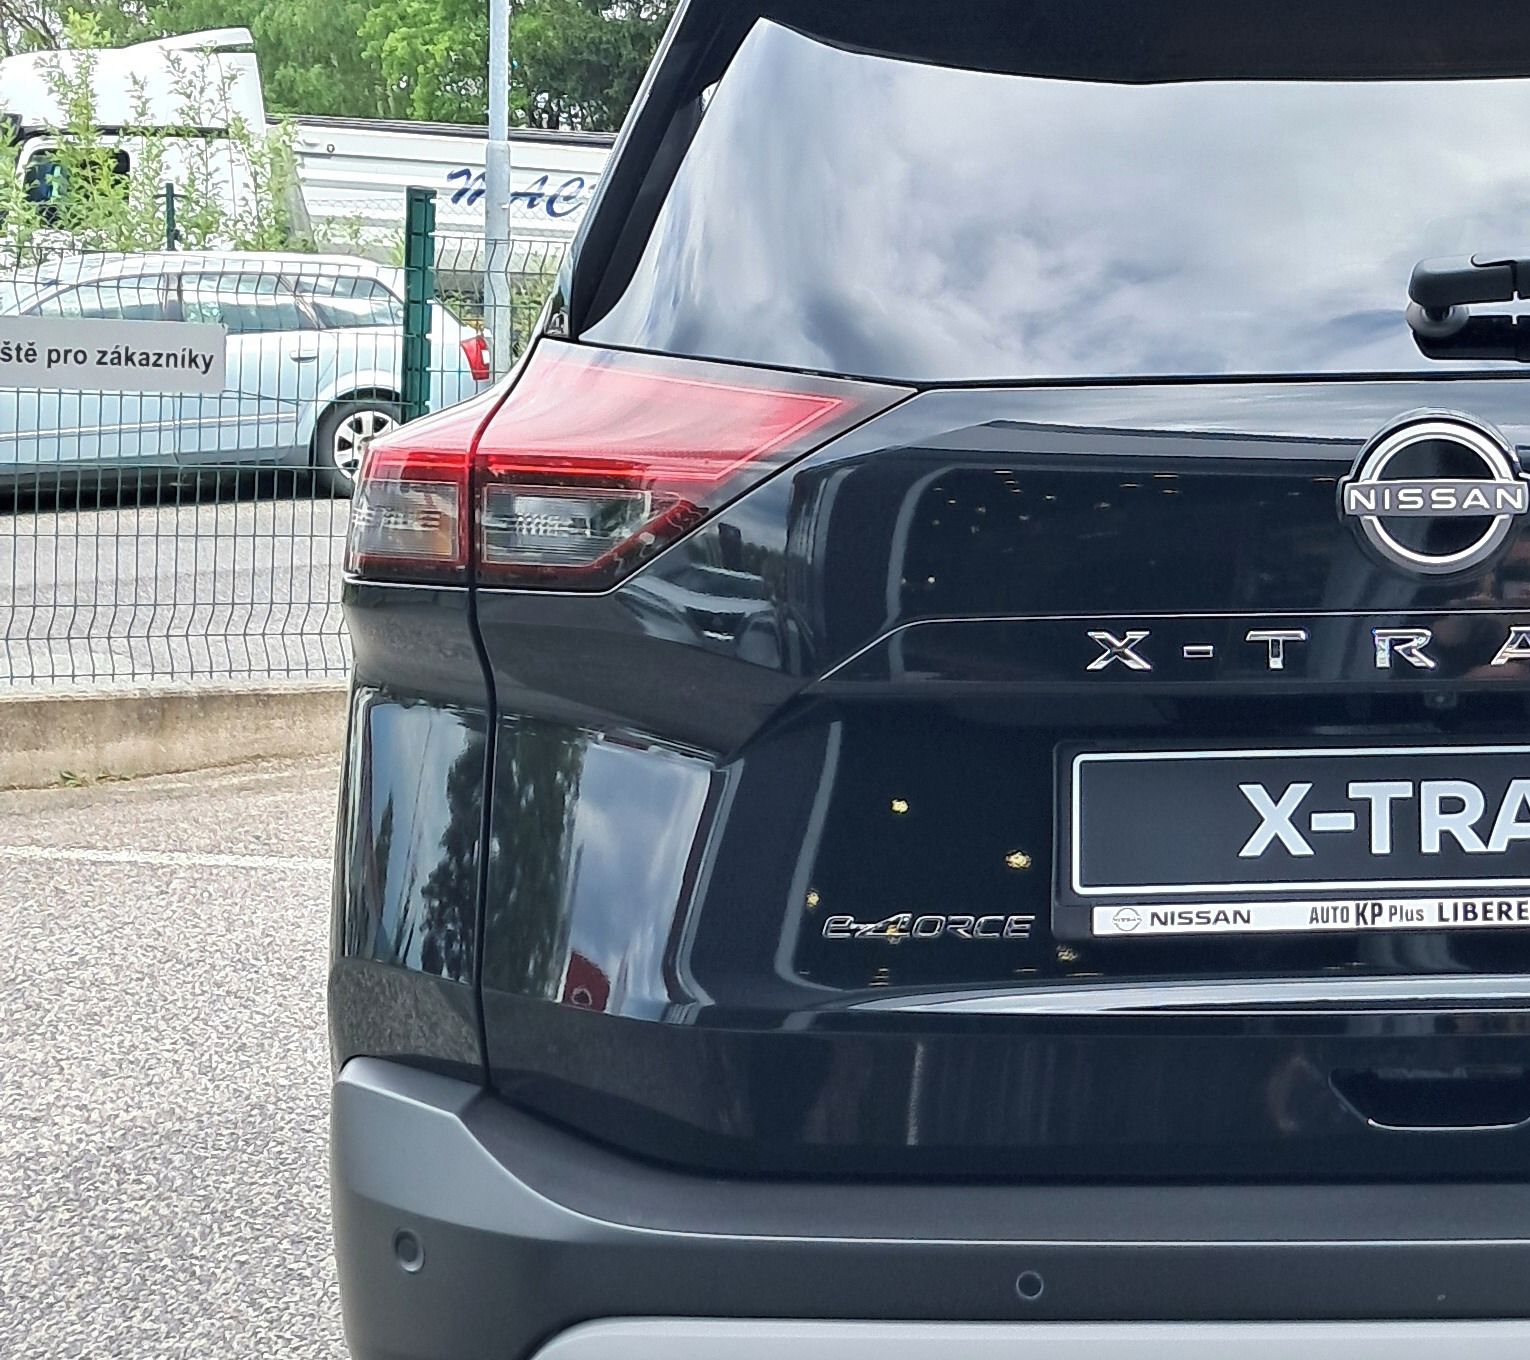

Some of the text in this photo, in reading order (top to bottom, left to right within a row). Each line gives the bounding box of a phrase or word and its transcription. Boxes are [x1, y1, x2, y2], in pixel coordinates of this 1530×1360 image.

[46, 347, 88, 369] pro
[96, 345, 214, 375] zákazníky
[1350, 488, 1523, 510] NISSAN
[1150, 909, 1251, 927] NISSAN
[1309, 905, 1349, 924] AUTO
[1355, 902, 1383, 926] KP
[1388, 904, 1424, 923] Plus
